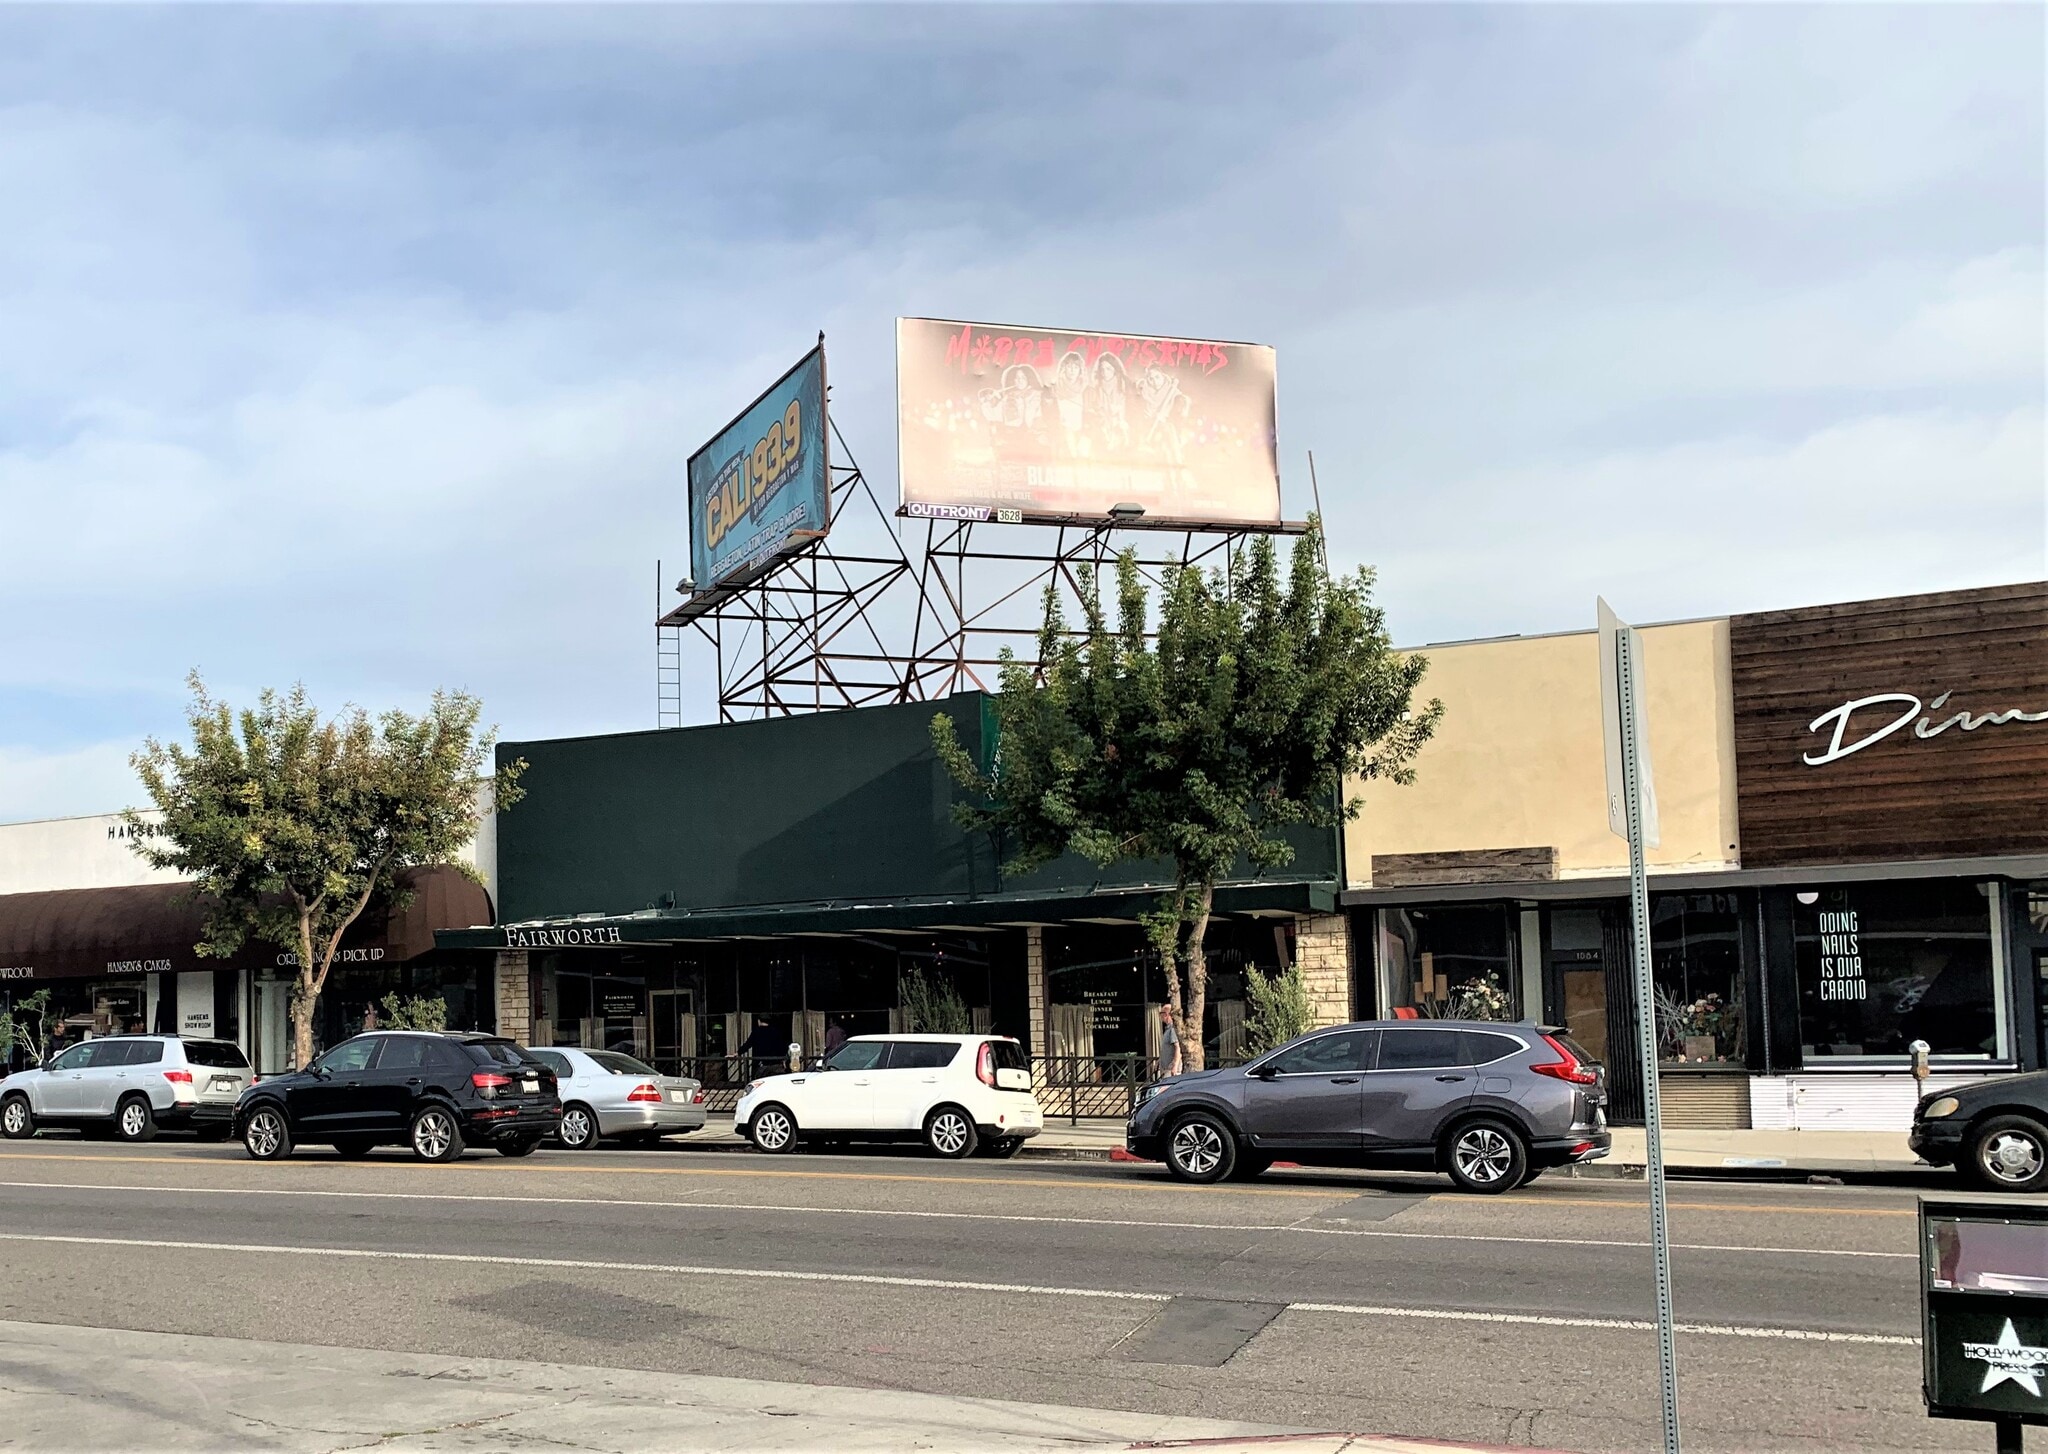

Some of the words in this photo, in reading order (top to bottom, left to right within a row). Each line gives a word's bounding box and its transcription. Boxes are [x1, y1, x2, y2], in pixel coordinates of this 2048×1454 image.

[706, 454, 751, 550] CALI
[752, 398, 801, 499] 93.9
[911, 503, 988, 519] OUTFRONT
[999, 510, 1021, 521] 3628
[761, 520, 779, 545] TRAP
[504, 922, 622, 947] FAIRWORTH
[1821, 934, 1859, 955] NAILS
[343, 948, 369, 962] PICK
[370, 947, 385, 960] UP
[107, 960, 142, 973] HANSEN'S
[143, 958, 172, 971] CAKES
[1821, 957, 1834, 978] IS
[1837, 956, 1862, 978] OUR
[1083, 990, 1118, 998] BREAKFAST
[1820, 978, 1867, 1001] CARDIO
[1992, 1361, 2029, 1374] PRESS
